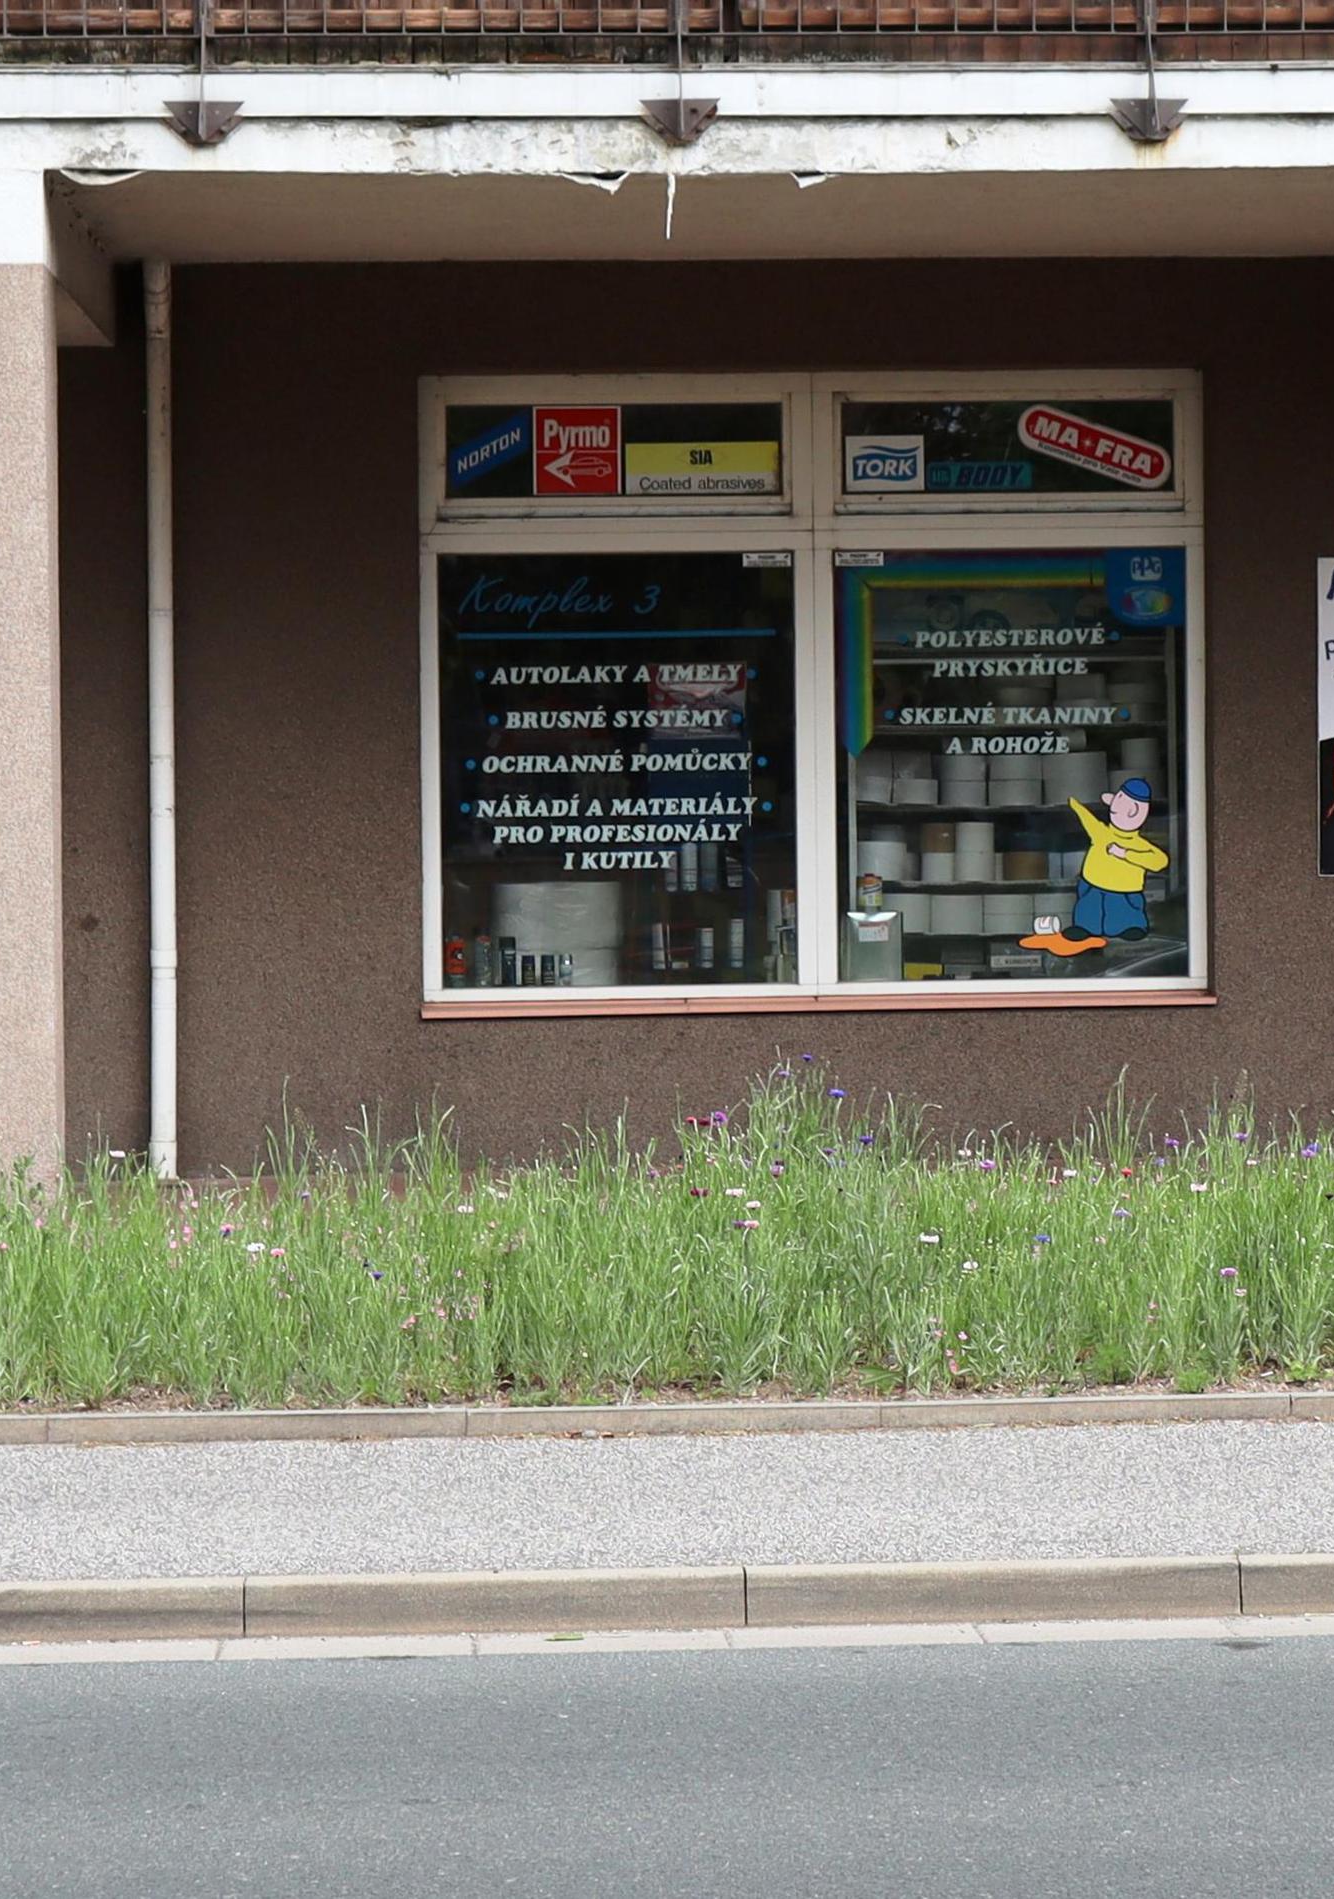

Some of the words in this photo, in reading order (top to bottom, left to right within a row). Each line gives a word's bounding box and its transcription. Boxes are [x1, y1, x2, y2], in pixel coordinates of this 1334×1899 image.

[544, 419, 611, 454] Pyrmo
[457, 427, 521, 475] NORTON
[689, 450, 713, 466] SIA
[854, 458, 915, 478] TORK
[955, 464, 1024, 488] BODY
[639, 476, 693, 491] Coated
[697, 476, 765, 491] abrasives
[1131, 556, 1162, 578] PPG
[457, 574, 615, 629] Komplex
[633, 584, 662, 615] 3
[914, 622, 1106, 649] POLYESTEROVÉ
[490, 664, 629, 685] AUTOLAKY
[633, 664, 652, 683] A
[659, 663, 743, 683] TMELY
[932, 654, 1089, 678] PRYSKYŘICE
[505, 705, 608, 729] BRUSNÉ
[613, 704, 730, 728] SYSTÉMY
[898, 702, 996, 725] SKELNÉ
[1003, 707, 1117, 725] TKANINY
[945, 738, 964, 755] A
[970, 731, 1070, 755] ROHOŽE
[482, 750, 624, 774] OCHRANNÉ
[630, 748, 753, 773] POMŮCKY
[476, 793, 580, 818] NÁŘADÍ
[582, 799, 603, 818] A
[610, 792, 758, 818] MATERIÁLY
[492, 824, 544, 844] PRO
[549, 818, 743, 844] PROFESIONÁLY
[563, 851, 574, 870] I
[580, 850, 677, 870] KUTILY
